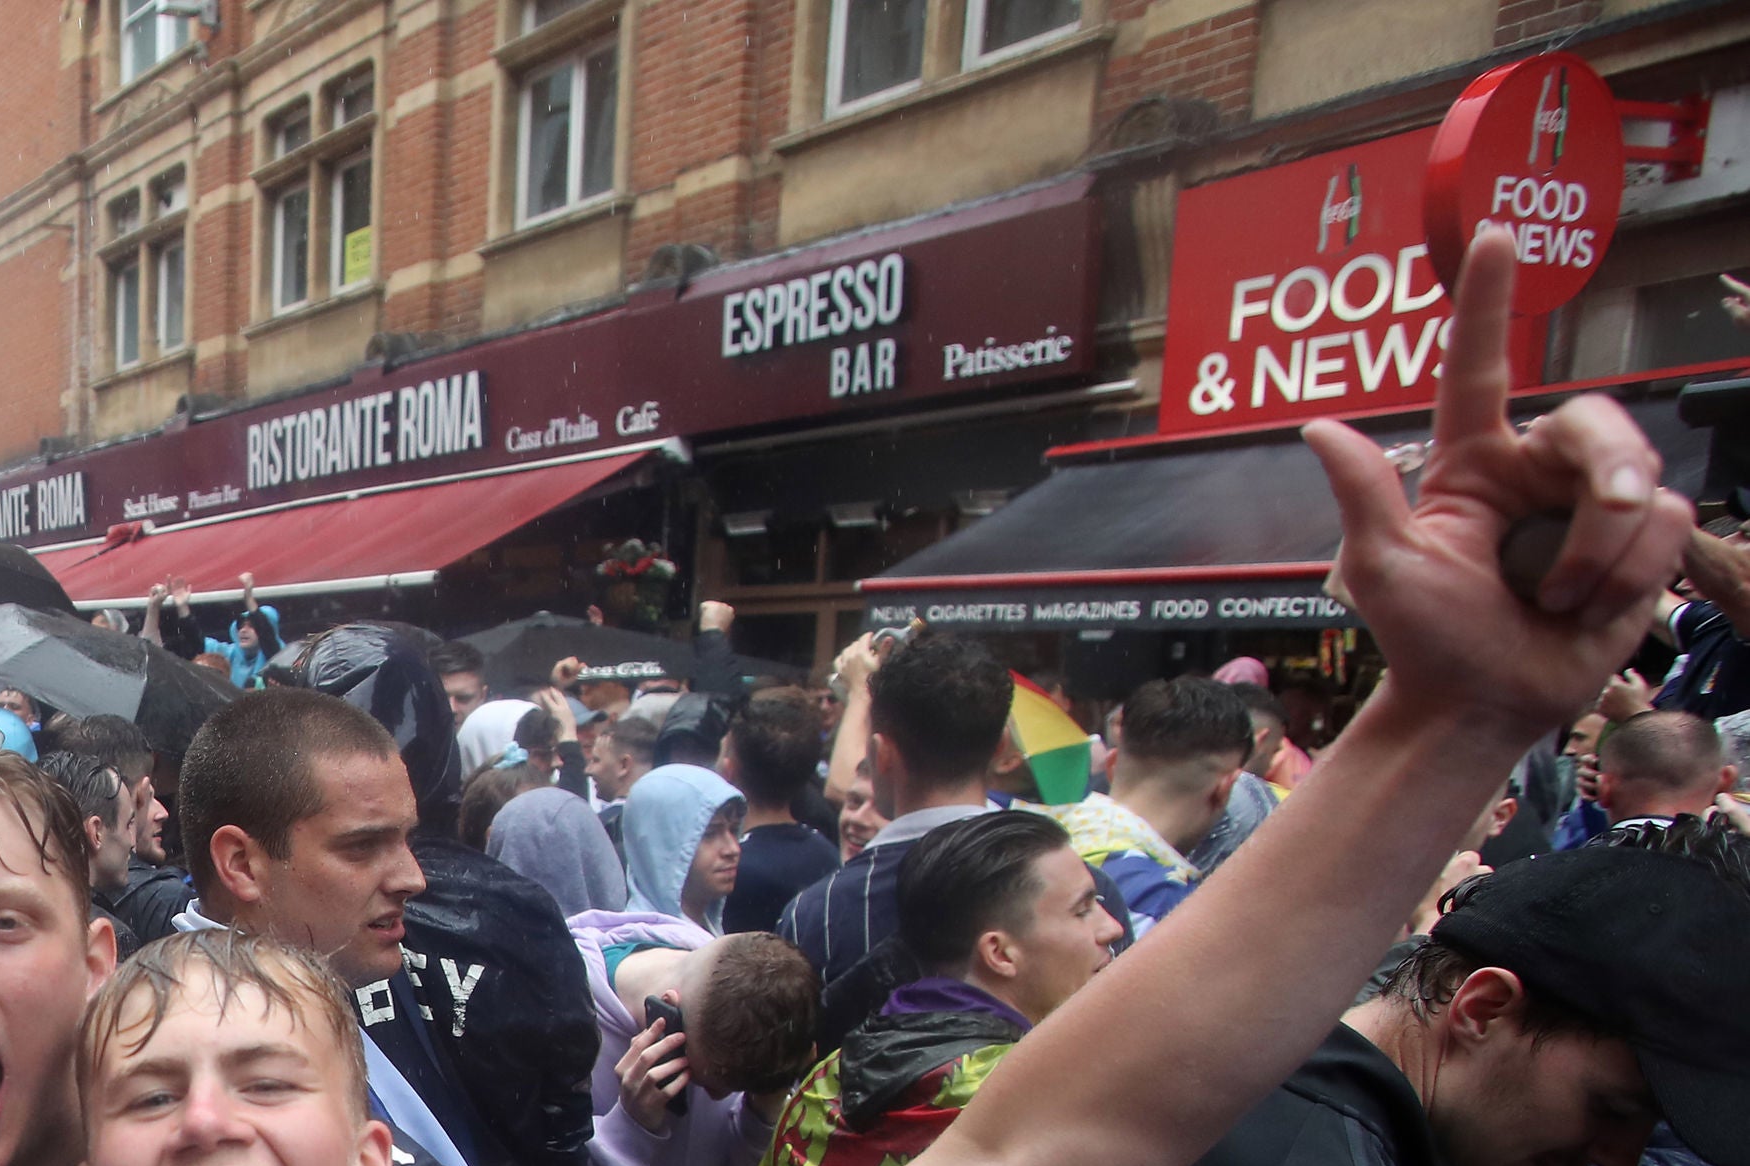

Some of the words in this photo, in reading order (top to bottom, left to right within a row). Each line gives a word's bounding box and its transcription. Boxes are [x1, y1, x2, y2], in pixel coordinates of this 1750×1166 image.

[1491, 175, 1587, 222] FOOD
[721, 253, 905, 358] ESPRESSO
[1228, 243, 1445, 342] FOOD
[830, 338, 897, 398] BAR
[943, 325, 1074, 381] Patisserie
[1188, 352, 1236, 415] &
[247, 391, 394, 490] RISTORANTE
[397, 369, 483, 462] ROMA
[505, 426, 542, 453] Casa
[37, 471, 85, 531] ROMA
[871, 606, 917, 621] NEWS
[926, 603, 1027, 622] CIGARETTES
[1033, 601, 1141, 621] MAGAZINES
[1151, 599, 1209, 619] FOOD
[1217, 597, 1345, 619] CONFECTIO
